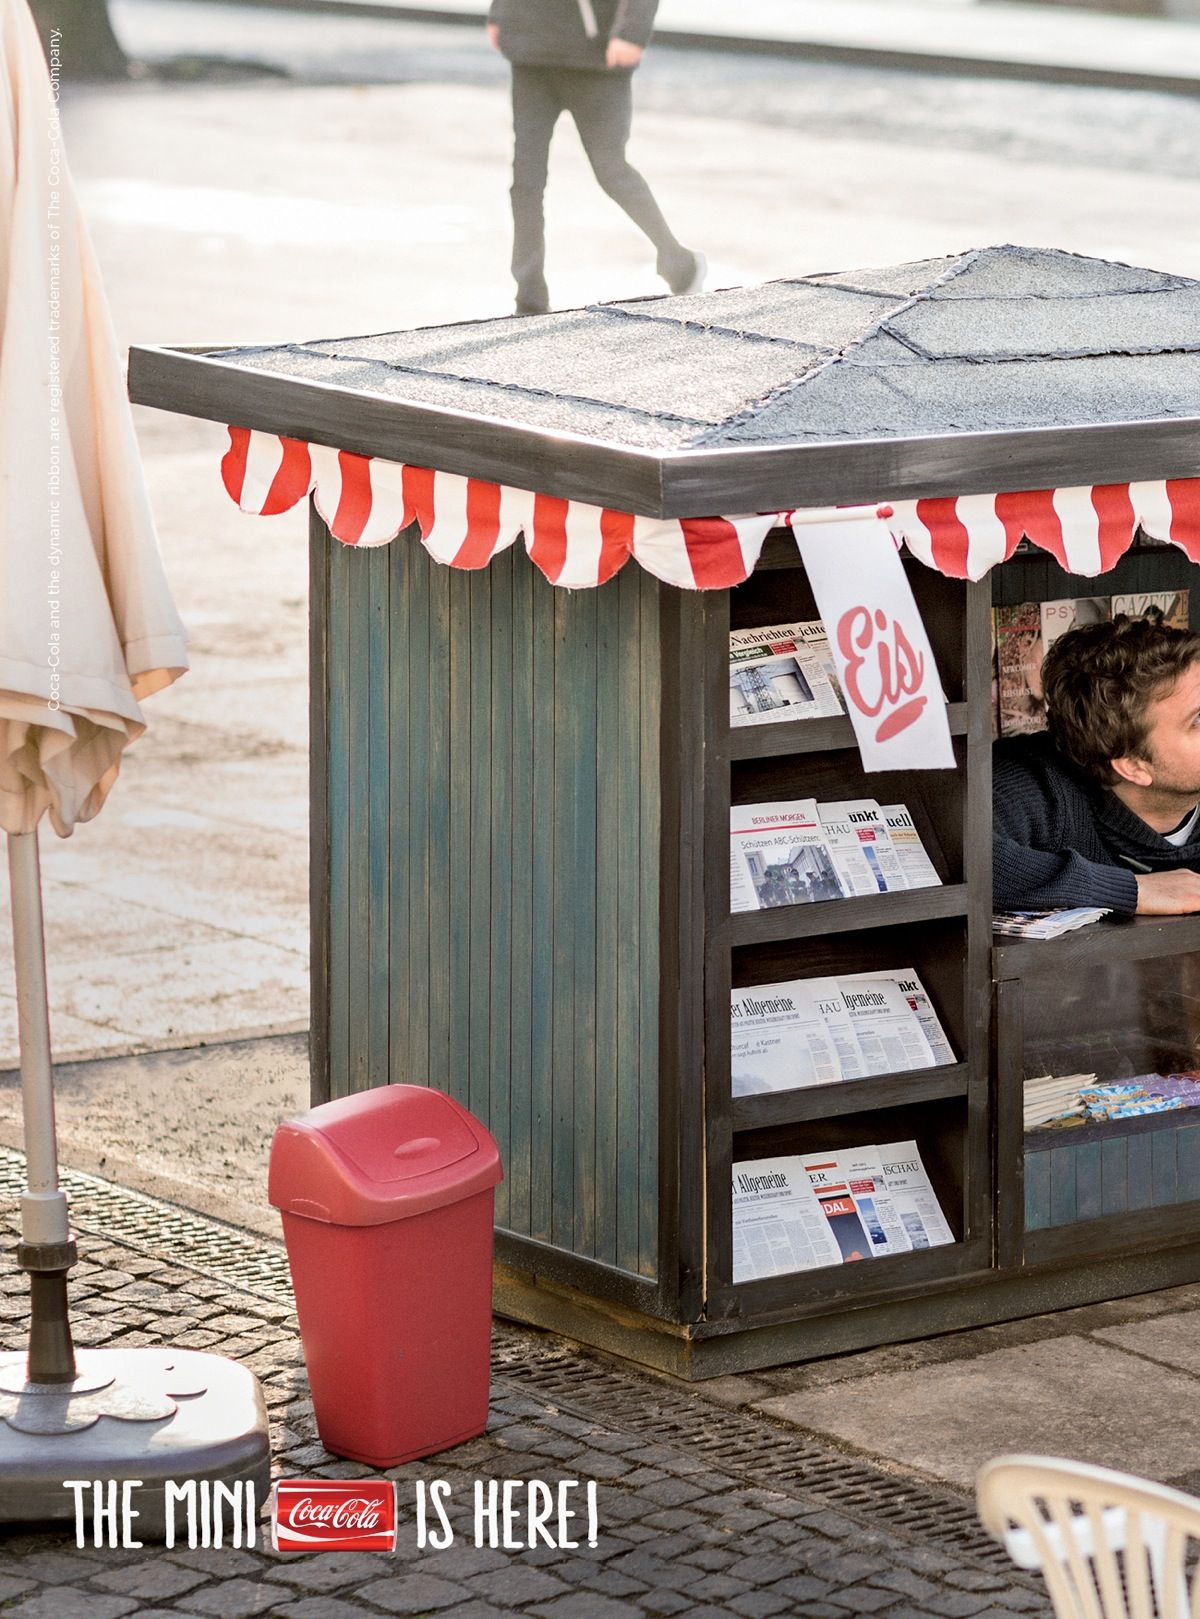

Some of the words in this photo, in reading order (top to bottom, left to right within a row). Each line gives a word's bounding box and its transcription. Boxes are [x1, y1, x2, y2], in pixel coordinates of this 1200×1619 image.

[731, 628, 795, 647] Nachrichten
[836, 604, 923, 718] Eis
[752, 814, 780, 825] BERLINER
[779, 813, 806, 822] MORGEN
[849, 810, 879, 823] unkt
[741, 995, 797, 1018] Allgemeine
[737, 1170, 790, 1194] Allgemeine
